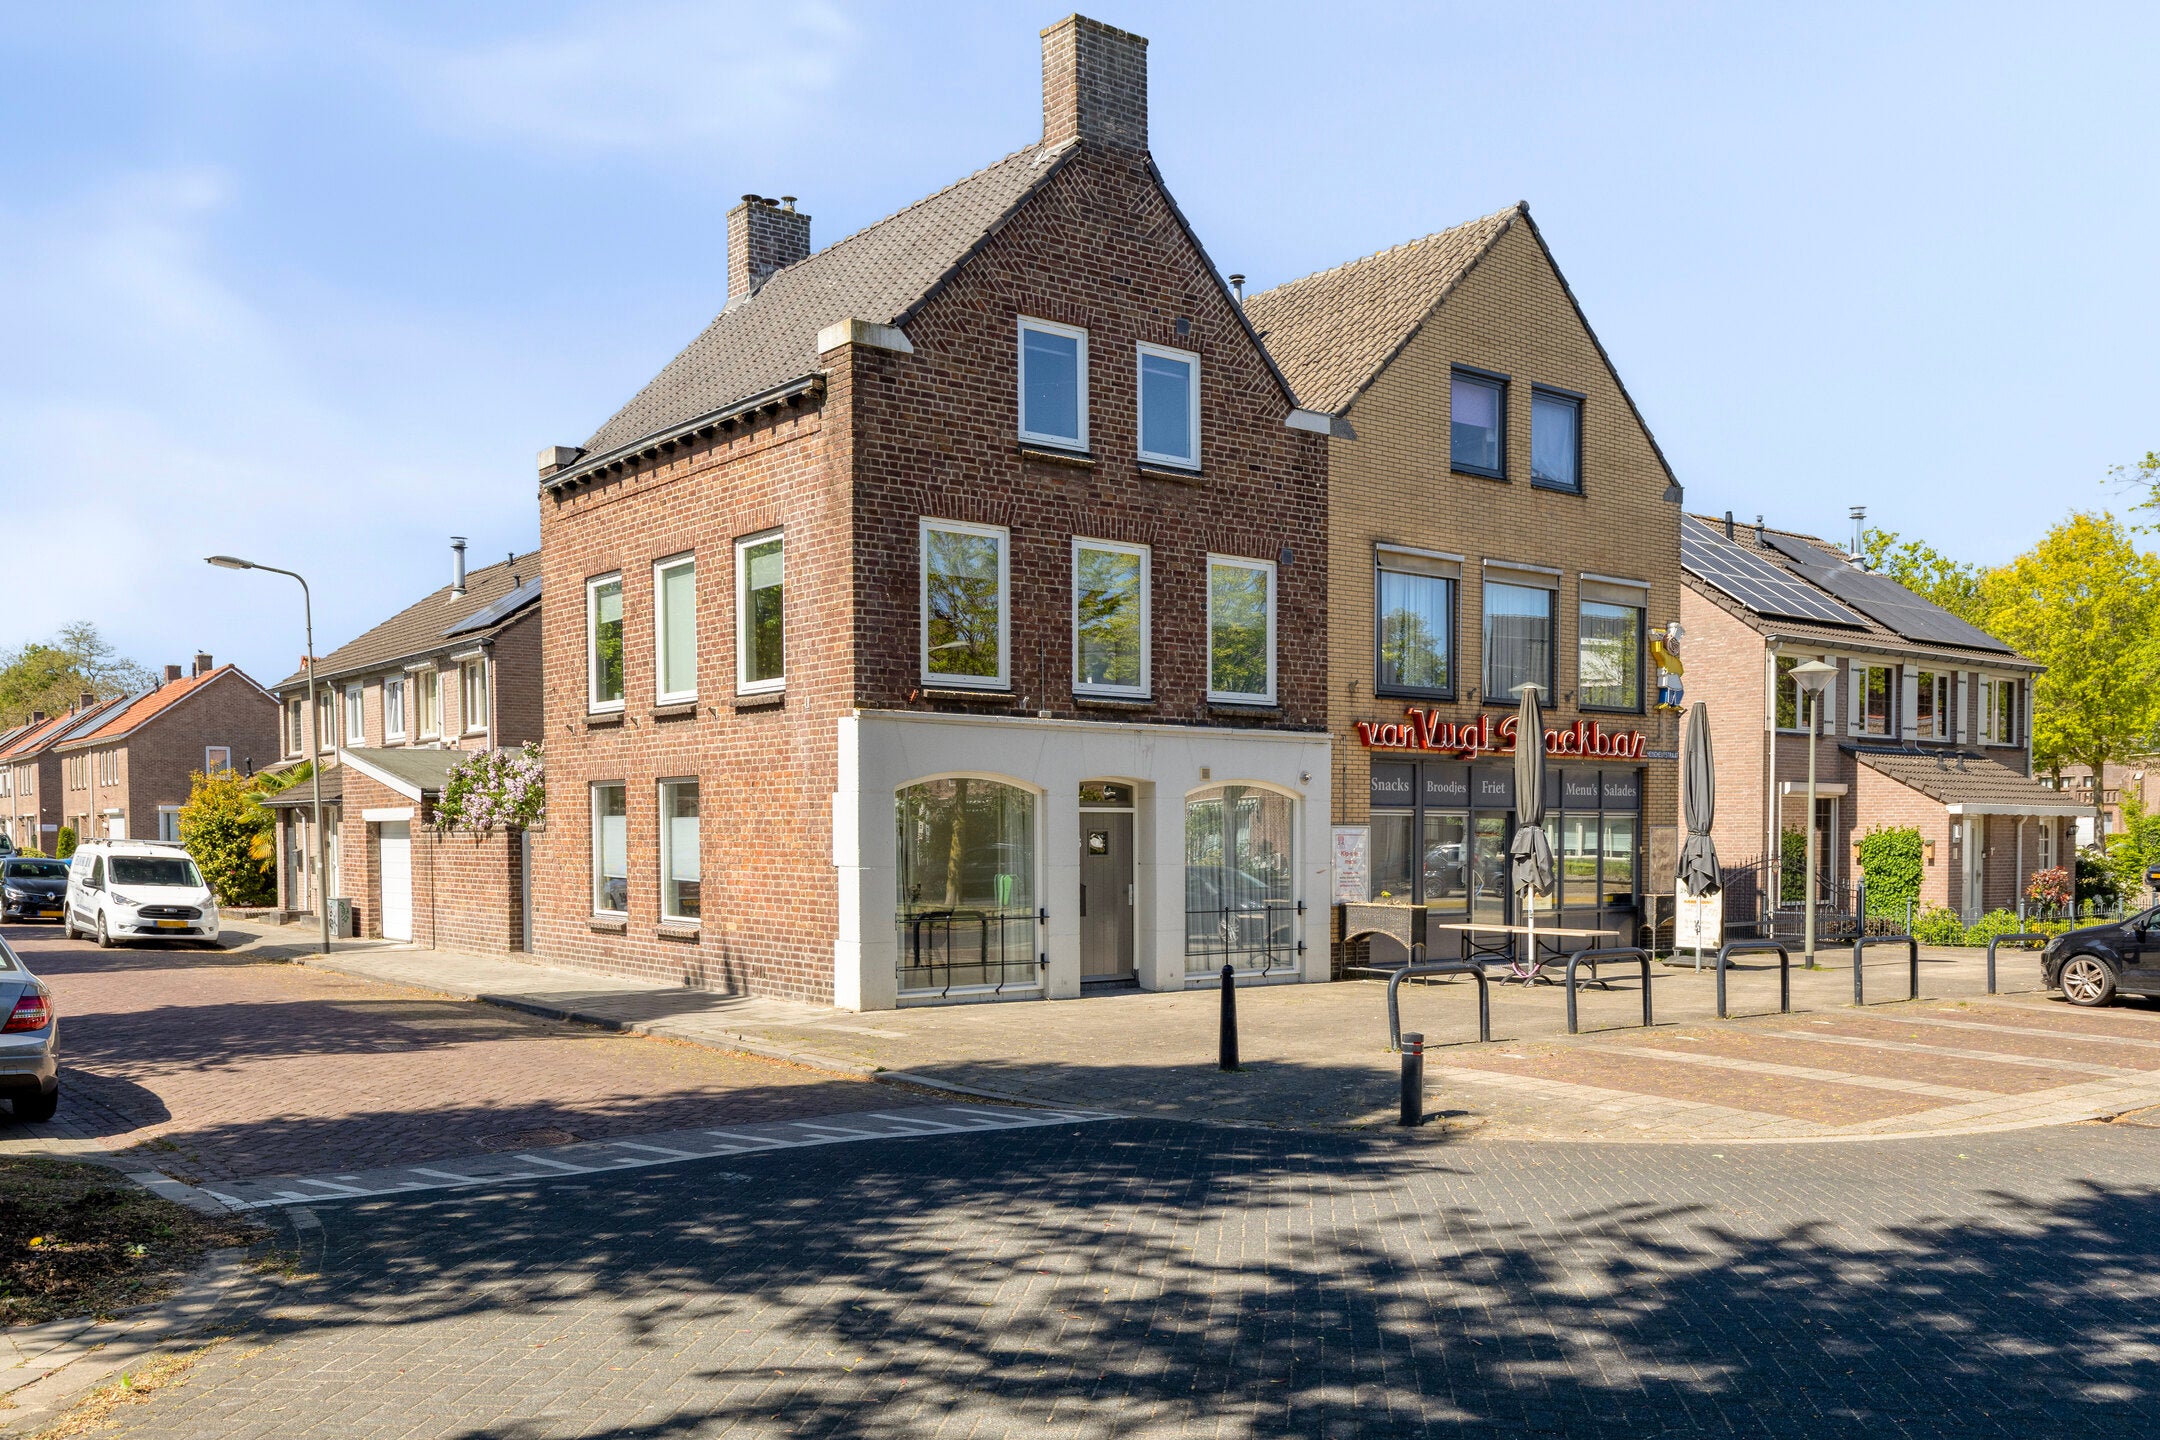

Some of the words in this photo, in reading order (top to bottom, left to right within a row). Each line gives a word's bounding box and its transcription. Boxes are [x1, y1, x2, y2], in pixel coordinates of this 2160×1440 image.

[1494, 714, 1648, 759] Sackbar
[1371, 777, 1409, 792] Snacks
[1427, 780, 1467, 796] Broodjes
[1482, 780, 1506, 794] Friet
[1566, 783, 1598, 796] Menu's
[1604, 783, 1637, 797] Salades
